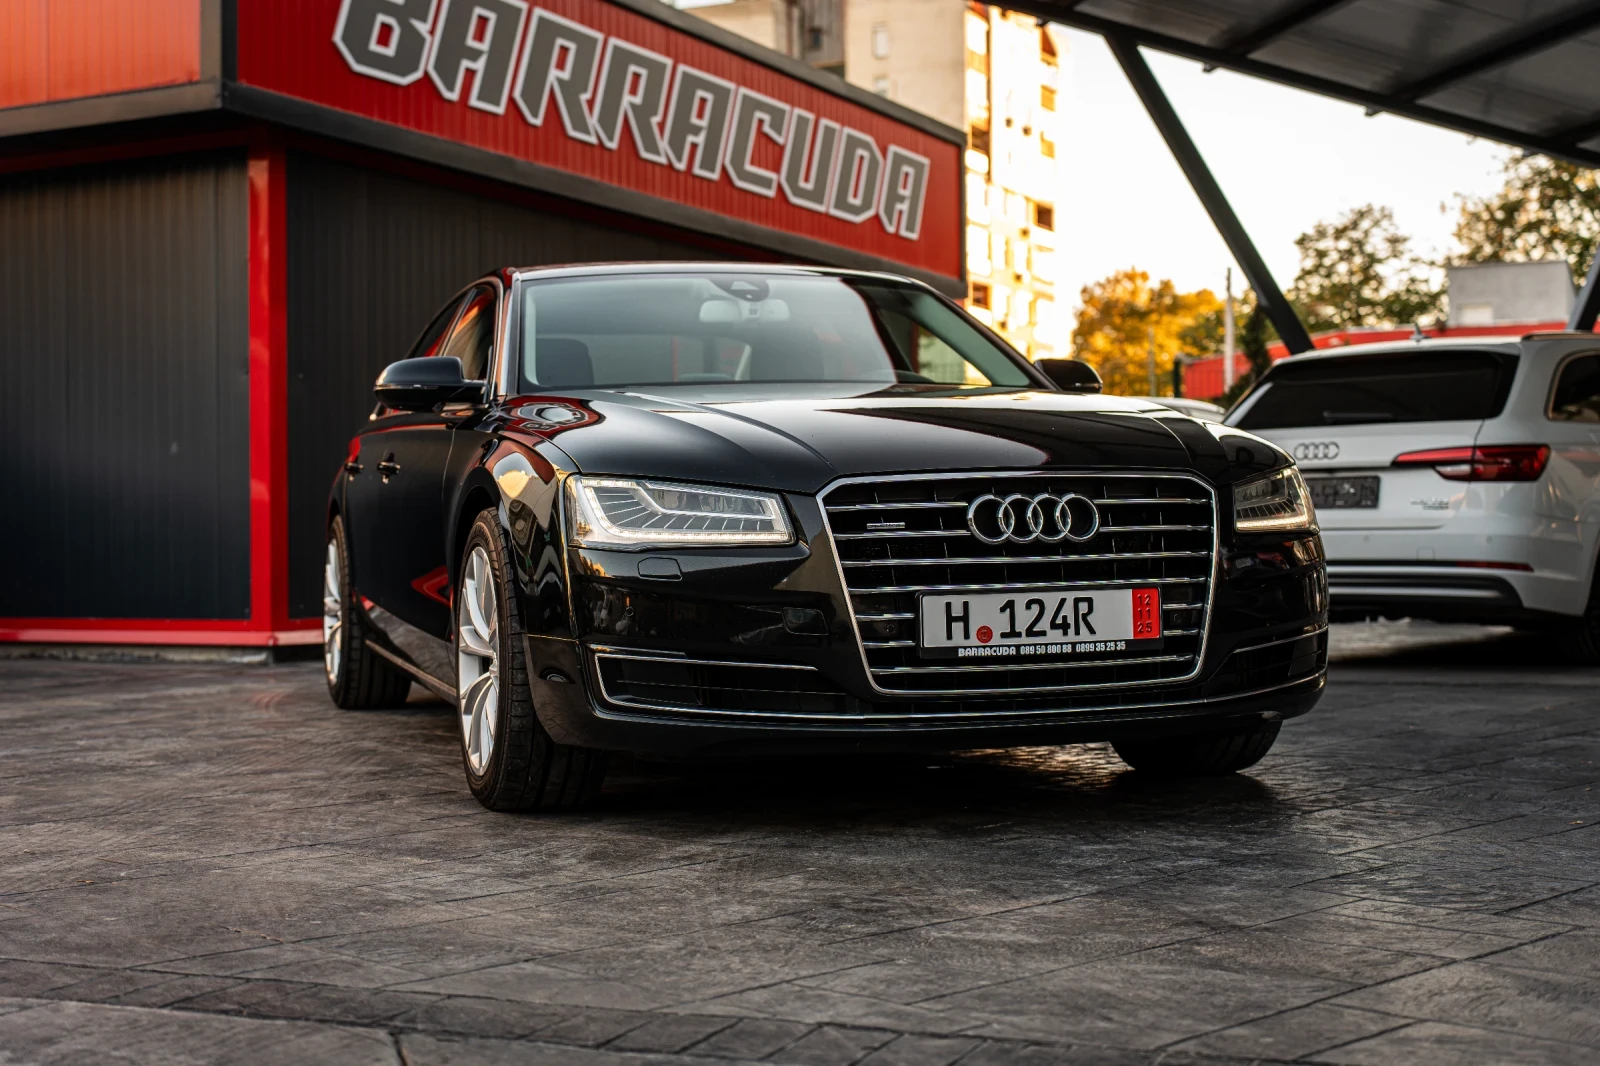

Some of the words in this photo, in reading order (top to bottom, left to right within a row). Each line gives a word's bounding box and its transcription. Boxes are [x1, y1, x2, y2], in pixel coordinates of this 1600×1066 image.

[332, 0, 930, 241] BARRACUDA
[1137, 594, 1152, 607] 12
[945, 600, 970, 641] H
[999, 596, 1097, 639] 124R
[1137, 607, 1151, 621] 11
[1137, 621, 1153, 634] 25
[958, 645, 1017, 657] BARRACUDA
